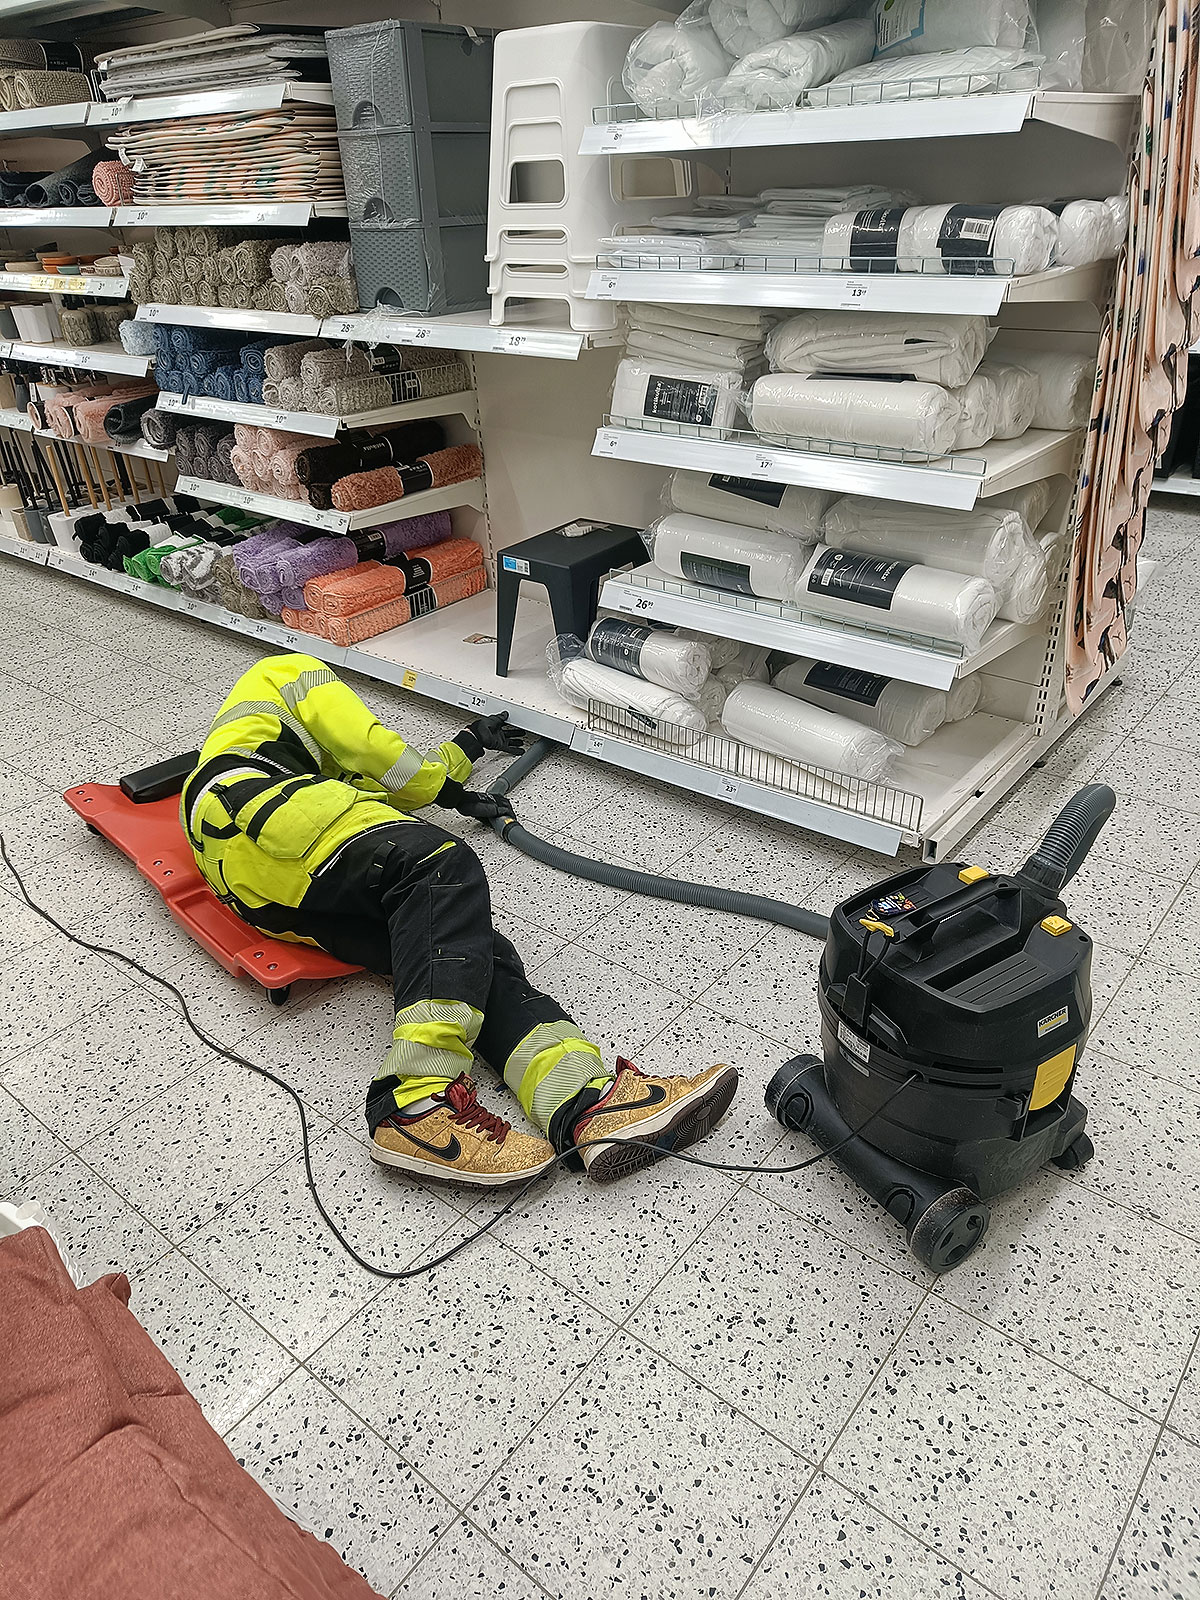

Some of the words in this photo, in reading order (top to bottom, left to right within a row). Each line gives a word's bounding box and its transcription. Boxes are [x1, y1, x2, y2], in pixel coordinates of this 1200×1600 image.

[112, 107, 122, 117] 10
[137, 212, 148, 221] 10
[852, 289, 867, 298] 13
[149, 309, 159, 317] 10
[341, 323, 355, 333] 28
[415, 329, 431, 339] 28
[509, 336, 526, 347] 18
[168, 399, 178, 407] 10
[275, 415, 287, 424] 10
[190, 484, 200, 492] 10
[243, 497, 254, 505] 10
[132, 584, 141, 592] 14
[188, 602, 197, 611] 10
[230, 617, 240, 625] 14
[256, 625, 267, 633] 14
[286, 636, 298, 644] 14
[471, 696, 486, 707] 12
[725, 785, 737, 793] 23
